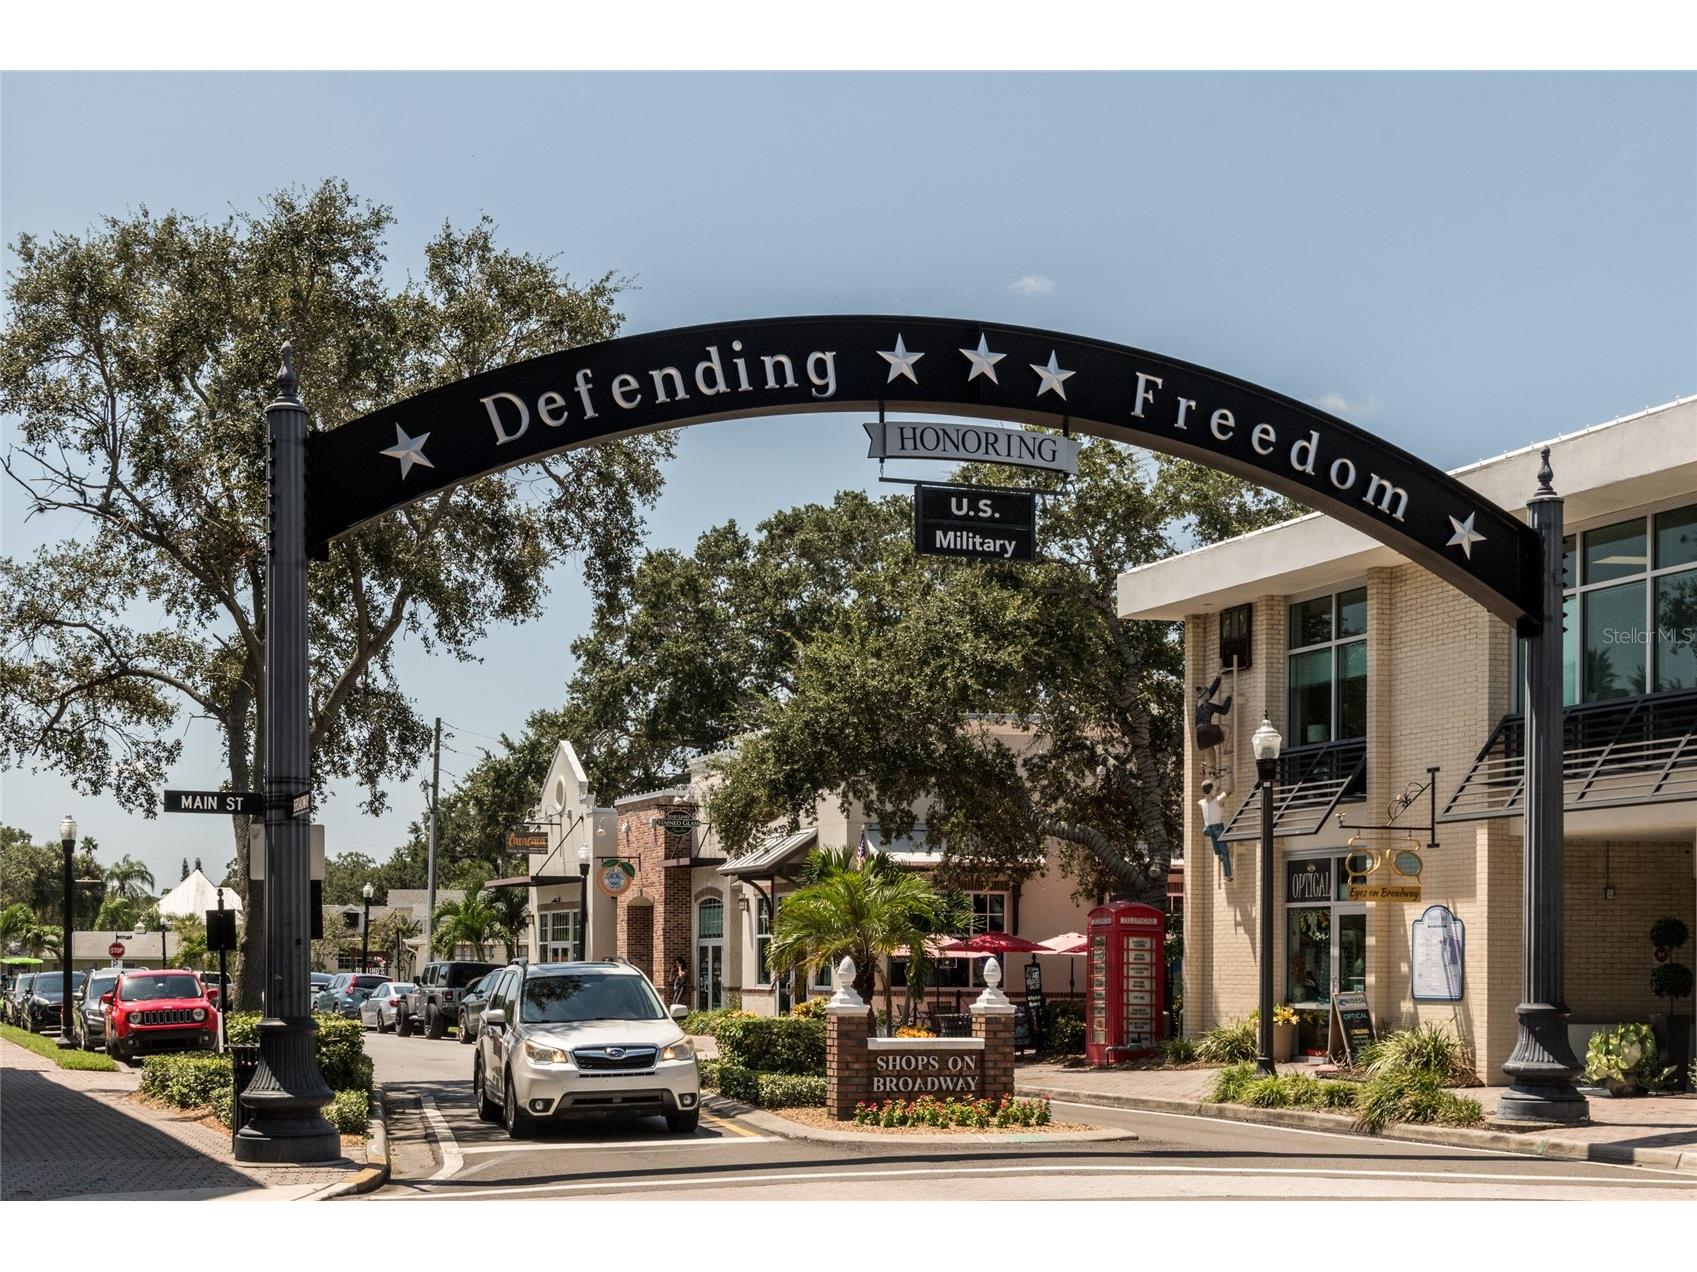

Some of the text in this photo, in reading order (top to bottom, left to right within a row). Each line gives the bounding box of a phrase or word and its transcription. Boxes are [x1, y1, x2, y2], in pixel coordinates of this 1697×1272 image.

[479, 340, 837, 447] Defending
[897, 426, 1059, 463] HONORING
[1130, 371, 1410, 523] Freedom
[950, 497, 1001, 519] U.S.
[935, 529, 1017, 559] Military
[181, 795, 244, 811] MAIN ST
[1292, 871, 1332, 898] OPTICAL
[1349, 886, 1420, 900] Eyes on Broadway
[1343, 1012, 1368, 1020] OPTICAL
[876, 1055, 977, 1071] SHOPS ON
[872, 1076, 979, 1092] BROADWAY
